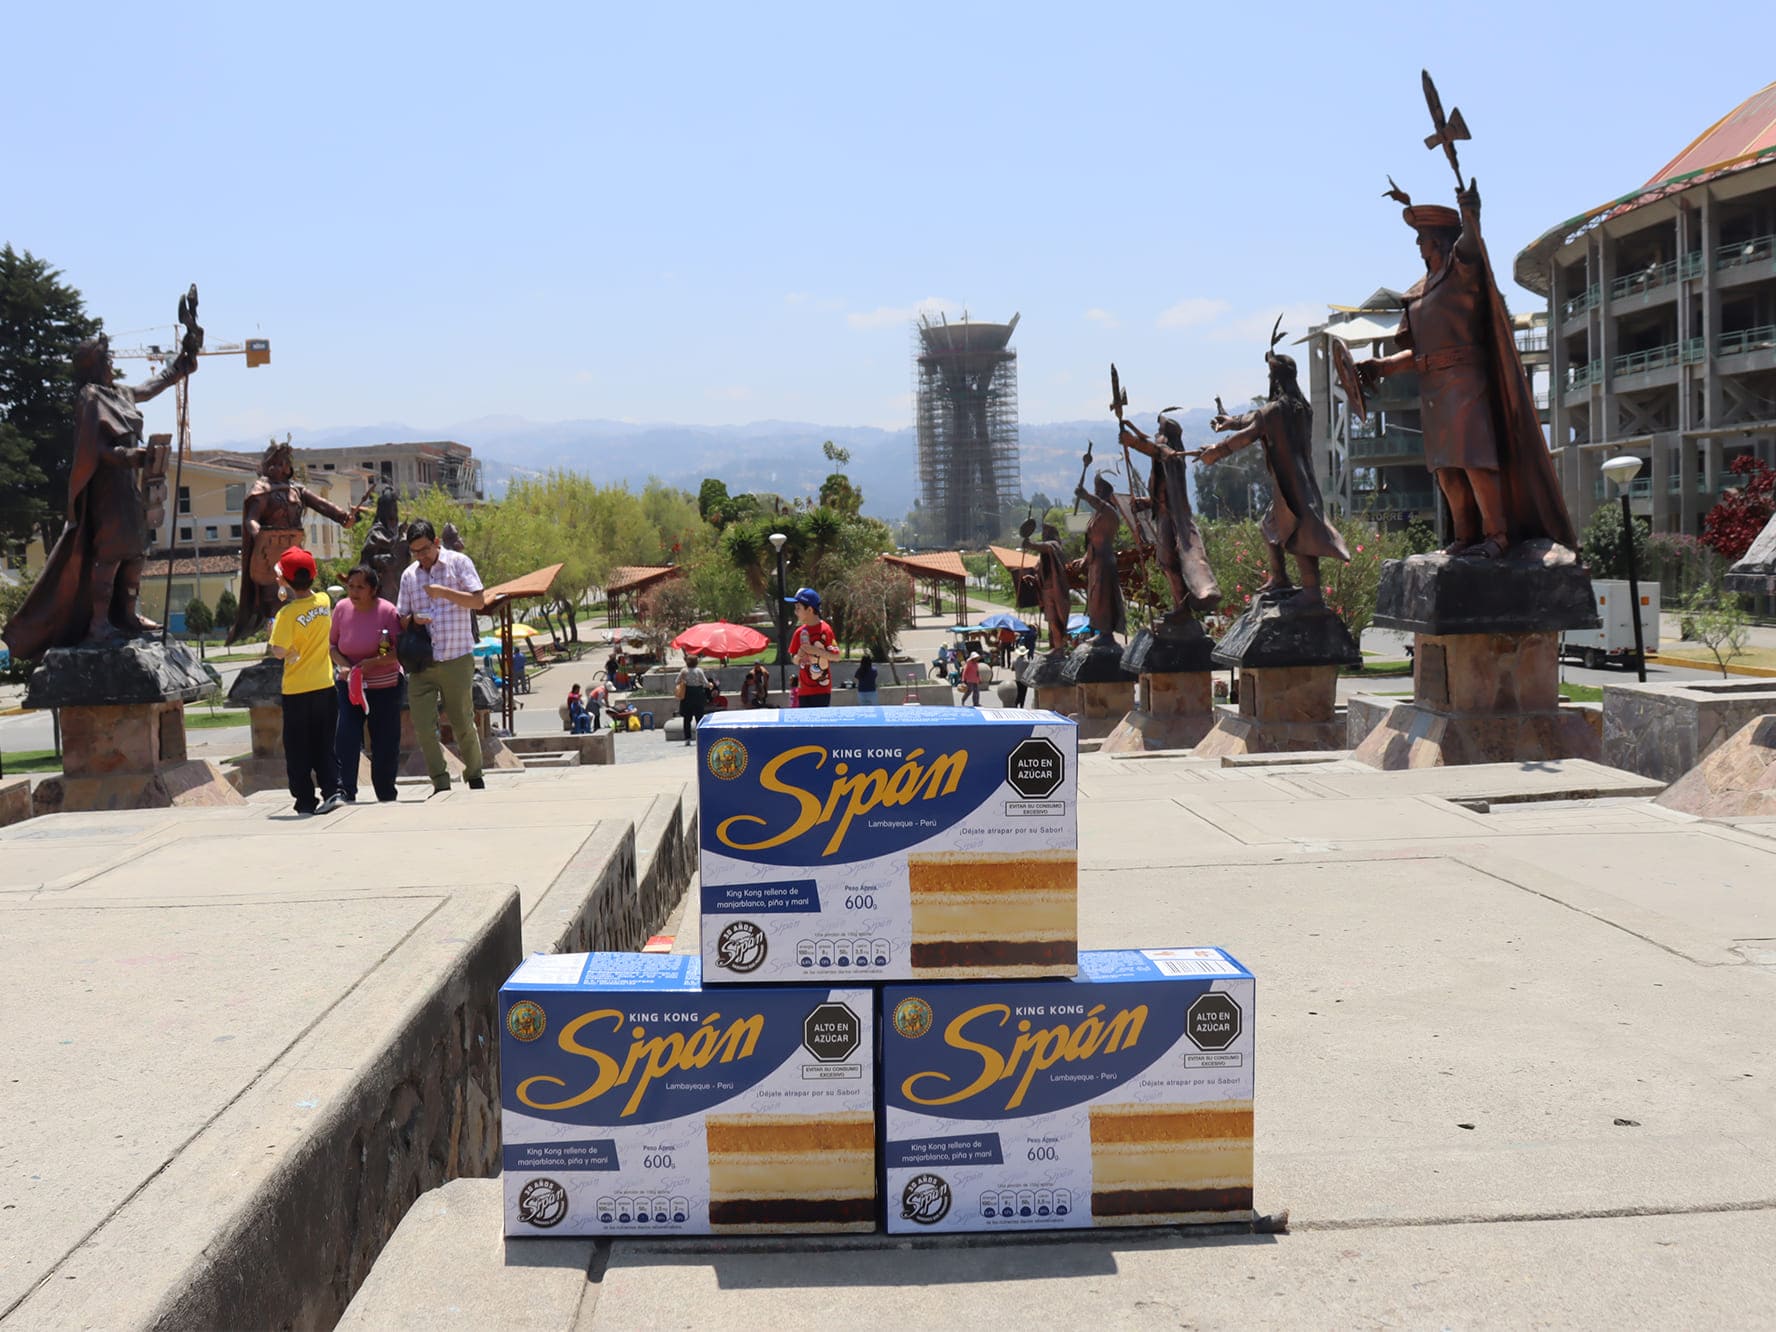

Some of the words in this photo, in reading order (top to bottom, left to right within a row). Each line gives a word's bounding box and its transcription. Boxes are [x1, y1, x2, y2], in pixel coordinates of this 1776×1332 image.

[832, 749, 862, 758] KING
[867, 748, 902, 758] KONG
[1018, 759, 1039, 768] ALTO
[1041, 759, 1053, 768] EN
[1018, 769, 1053, 779] AZÚCAR
[716, 745, 968, 856] Sipán
[868, 820, 913, 829] Lambayeque
[960, 827, 985, 835] ¡Déjate
[716, 900, 766, 909] manjarblanco,
[768, 899, 784, 908] piña
[733, 922, 754, 932] AÑOS
[1016, 1006, 1044, 1016] KING
[1050, 1005, 1084, 1014] KONG
[630, 1013, 658, 1022] KING
[664, 1012, 698, 1022] KONG
[814, 1024, 835, 1032] ALTO
[1196, 1022, 1230, 1032] AZÚCAR
[814, 1034, 848, 1042] AZÚCAR
[902, 1004, 1148, 1111] Sipán
[516, 1009, 765, 1117] Sipán
[666, 1082, 710, 1090] Lambayeque
[1139, 1080, 1164, 1088] ¡Déjate
[756, 1090, 782, 1098] ¡Déjate
[544, 1148, 562, 1156] Kong
[911, 1144, 926, 1152] King
[928, 1143, 946, 1151] Kong
[518, 1158, 566, 1166] manjarblanco,
[568, 1157, 582, 1166] piña
[902, 1154, 950, 1162] manjarblanco,
[952, 1152, 967, 1160] piña
[534, 1180, 554, 1188] AÑOS
[918, 1175, 937, 1184] AÑOS
